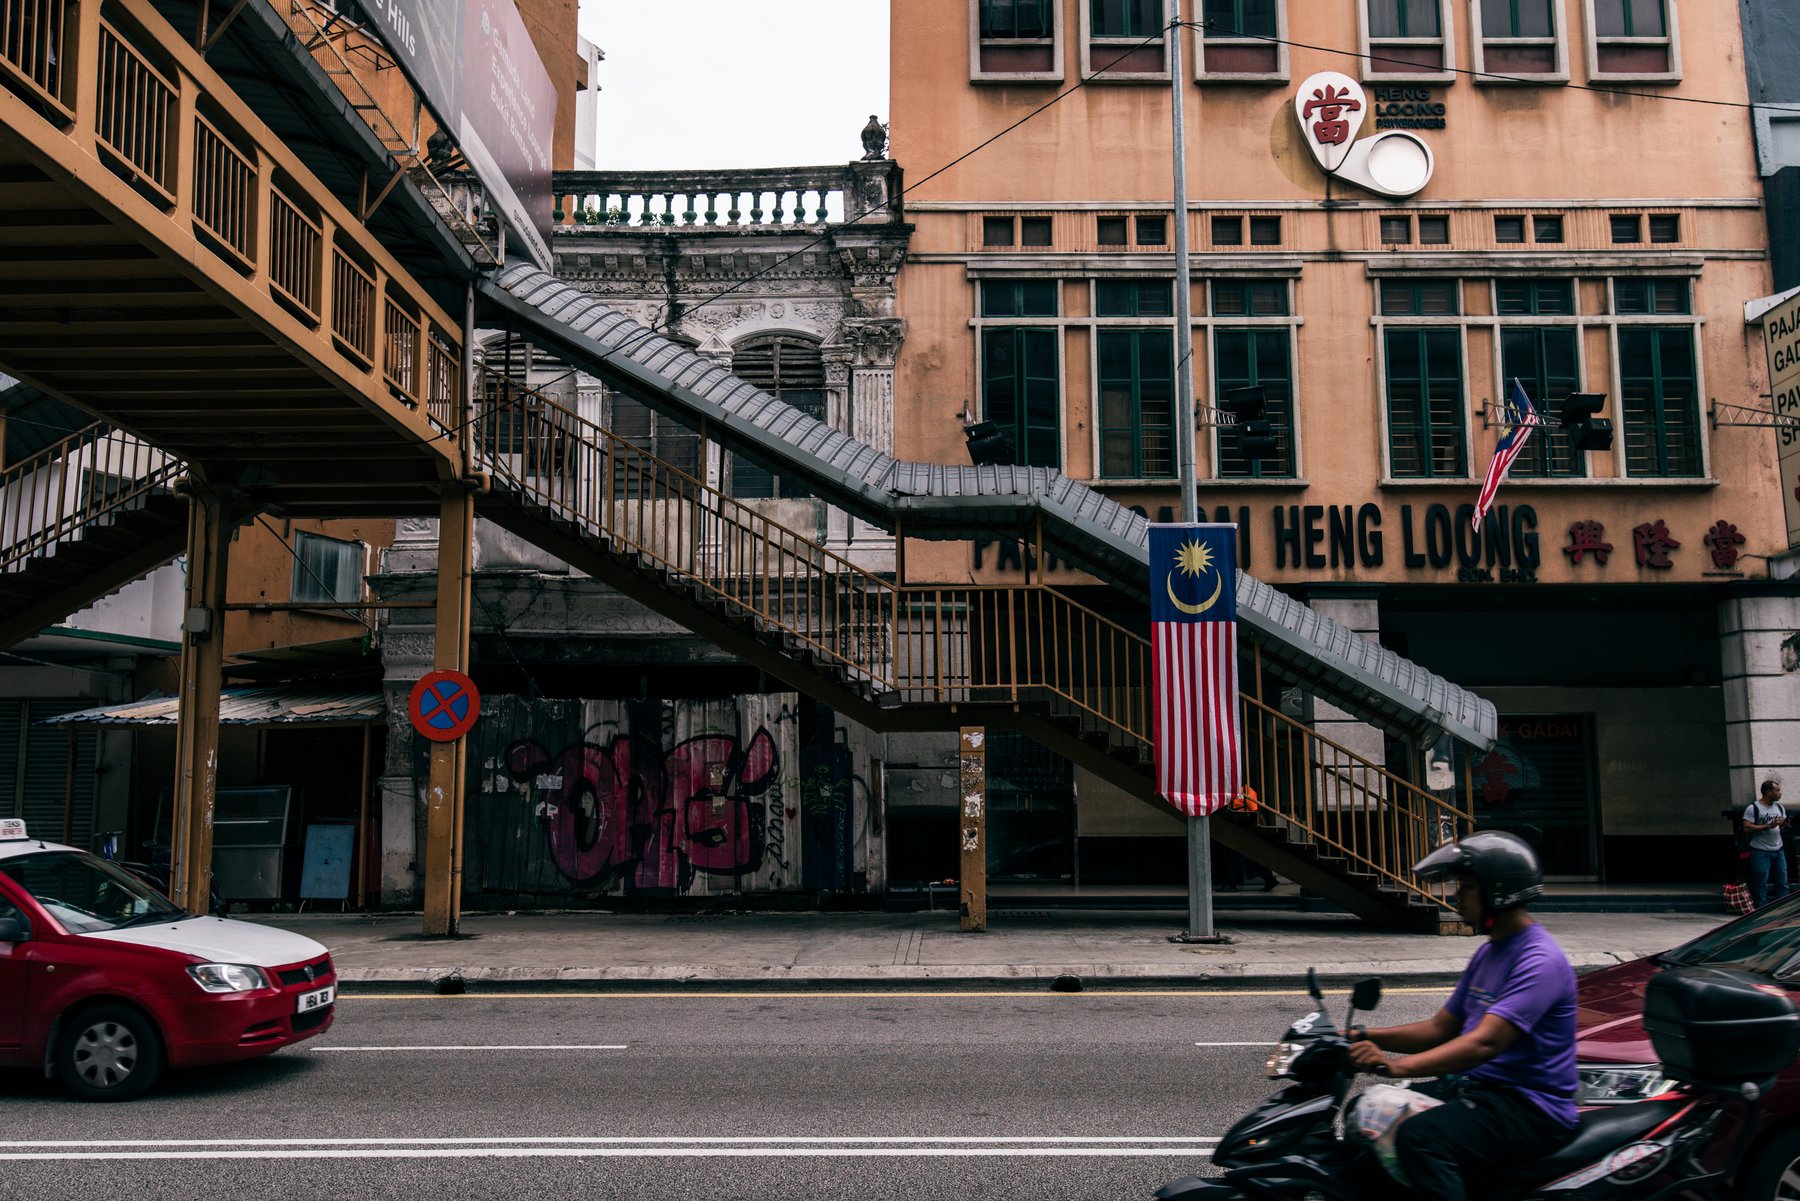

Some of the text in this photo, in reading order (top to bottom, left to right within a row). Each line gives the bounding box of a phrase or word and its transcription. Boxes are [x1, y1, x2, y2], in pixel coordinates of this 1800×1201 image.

[388, 0, 415, 56] Hills
[493, 28, 535, 120] Gamuda Land
[1375, 88, 1430, 101] HENG
[490, 81, 533, 172] Bukit Bintang
[491, 54, 547, 172] Experience Lounge
[1303, 84, 1361, 145] 當
[1376, 103, 1446, 116] LOONG
[1274, 502, 1383, 568] HENG
[1402, 503, 1541, 569] LOONG
[1518, 720, 1579, 739] GADAI
